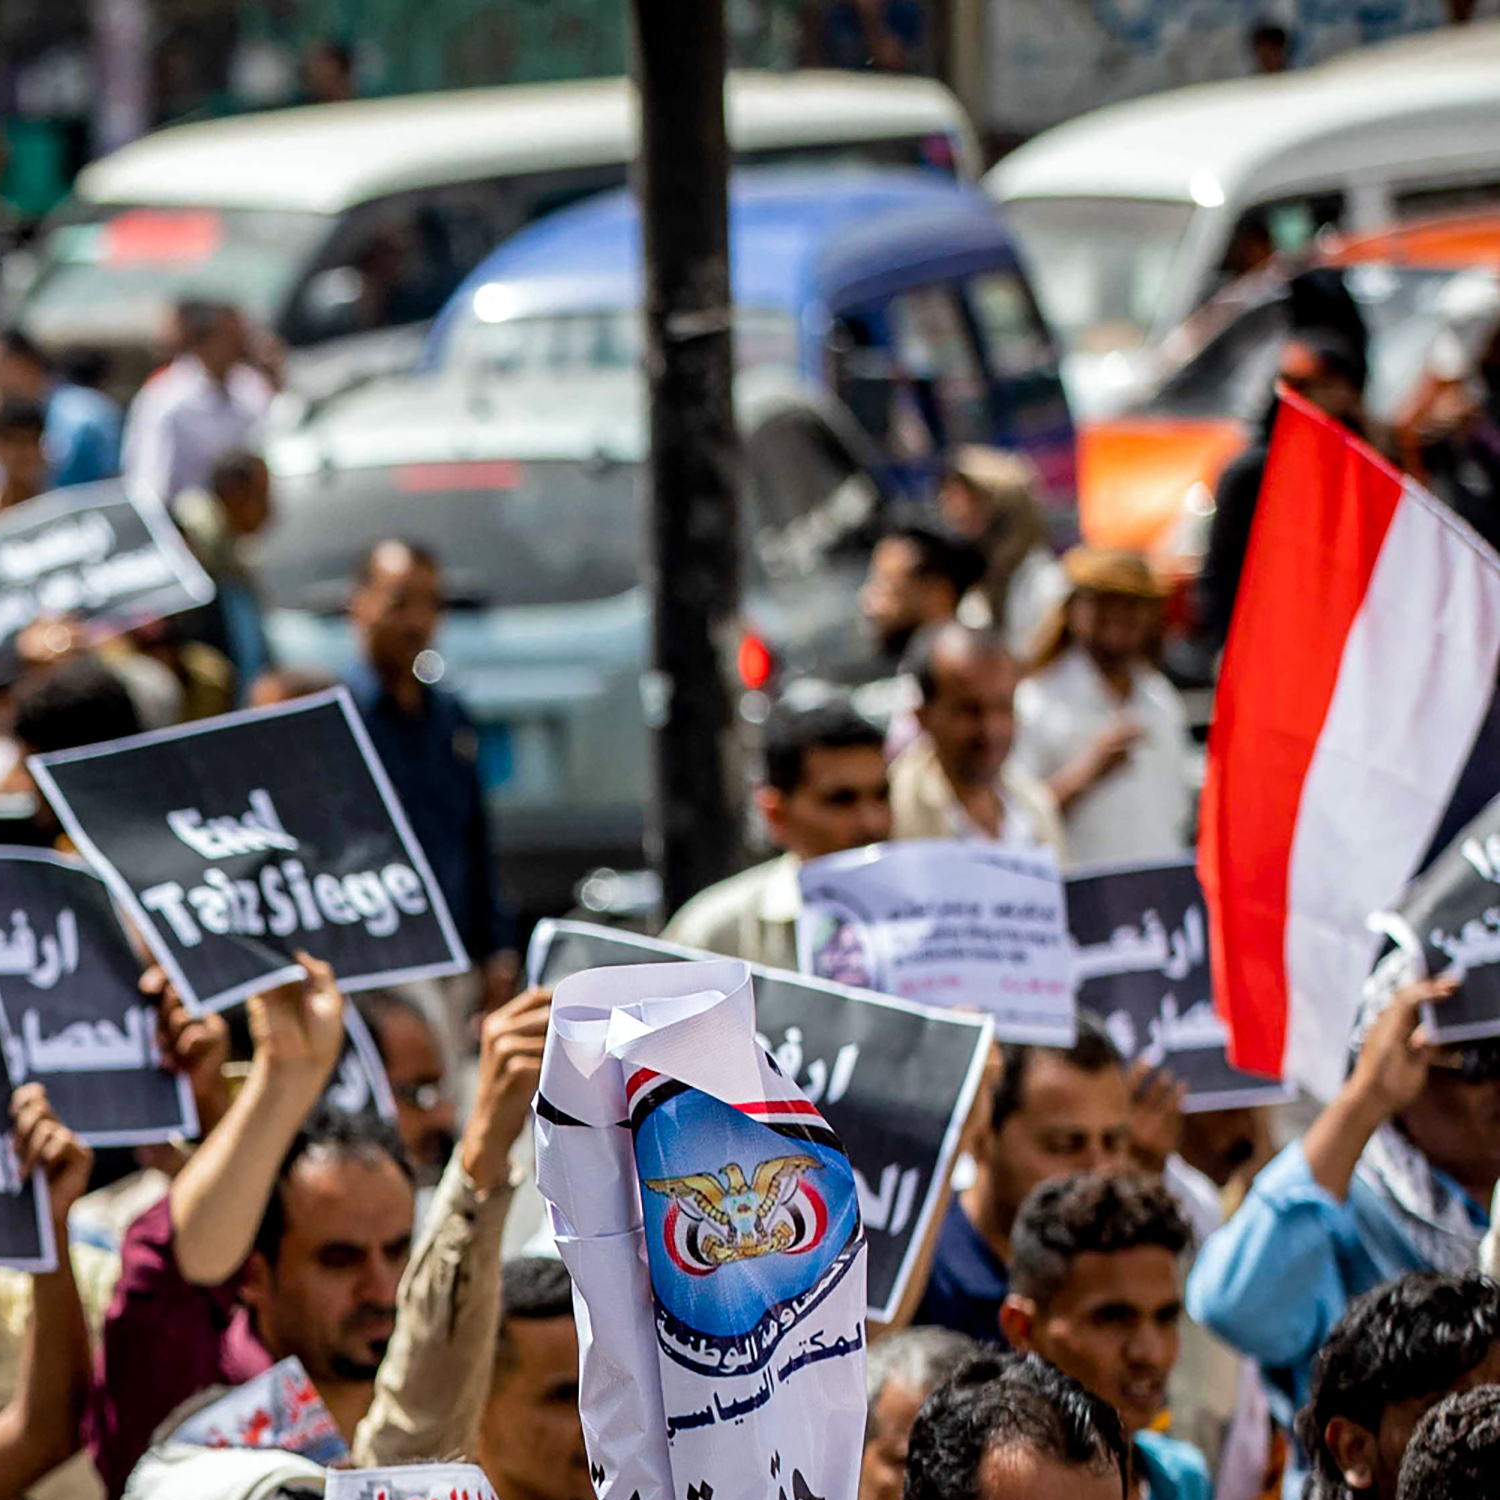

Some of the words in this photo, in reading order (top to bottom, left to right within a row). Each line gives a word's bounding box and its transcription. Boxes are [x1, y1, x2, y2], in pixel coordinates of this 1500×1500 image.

[166, 788, 299, 859] End
[140, 866, 266, 947] Taiz
[260, 859, 427, 937] Siege
